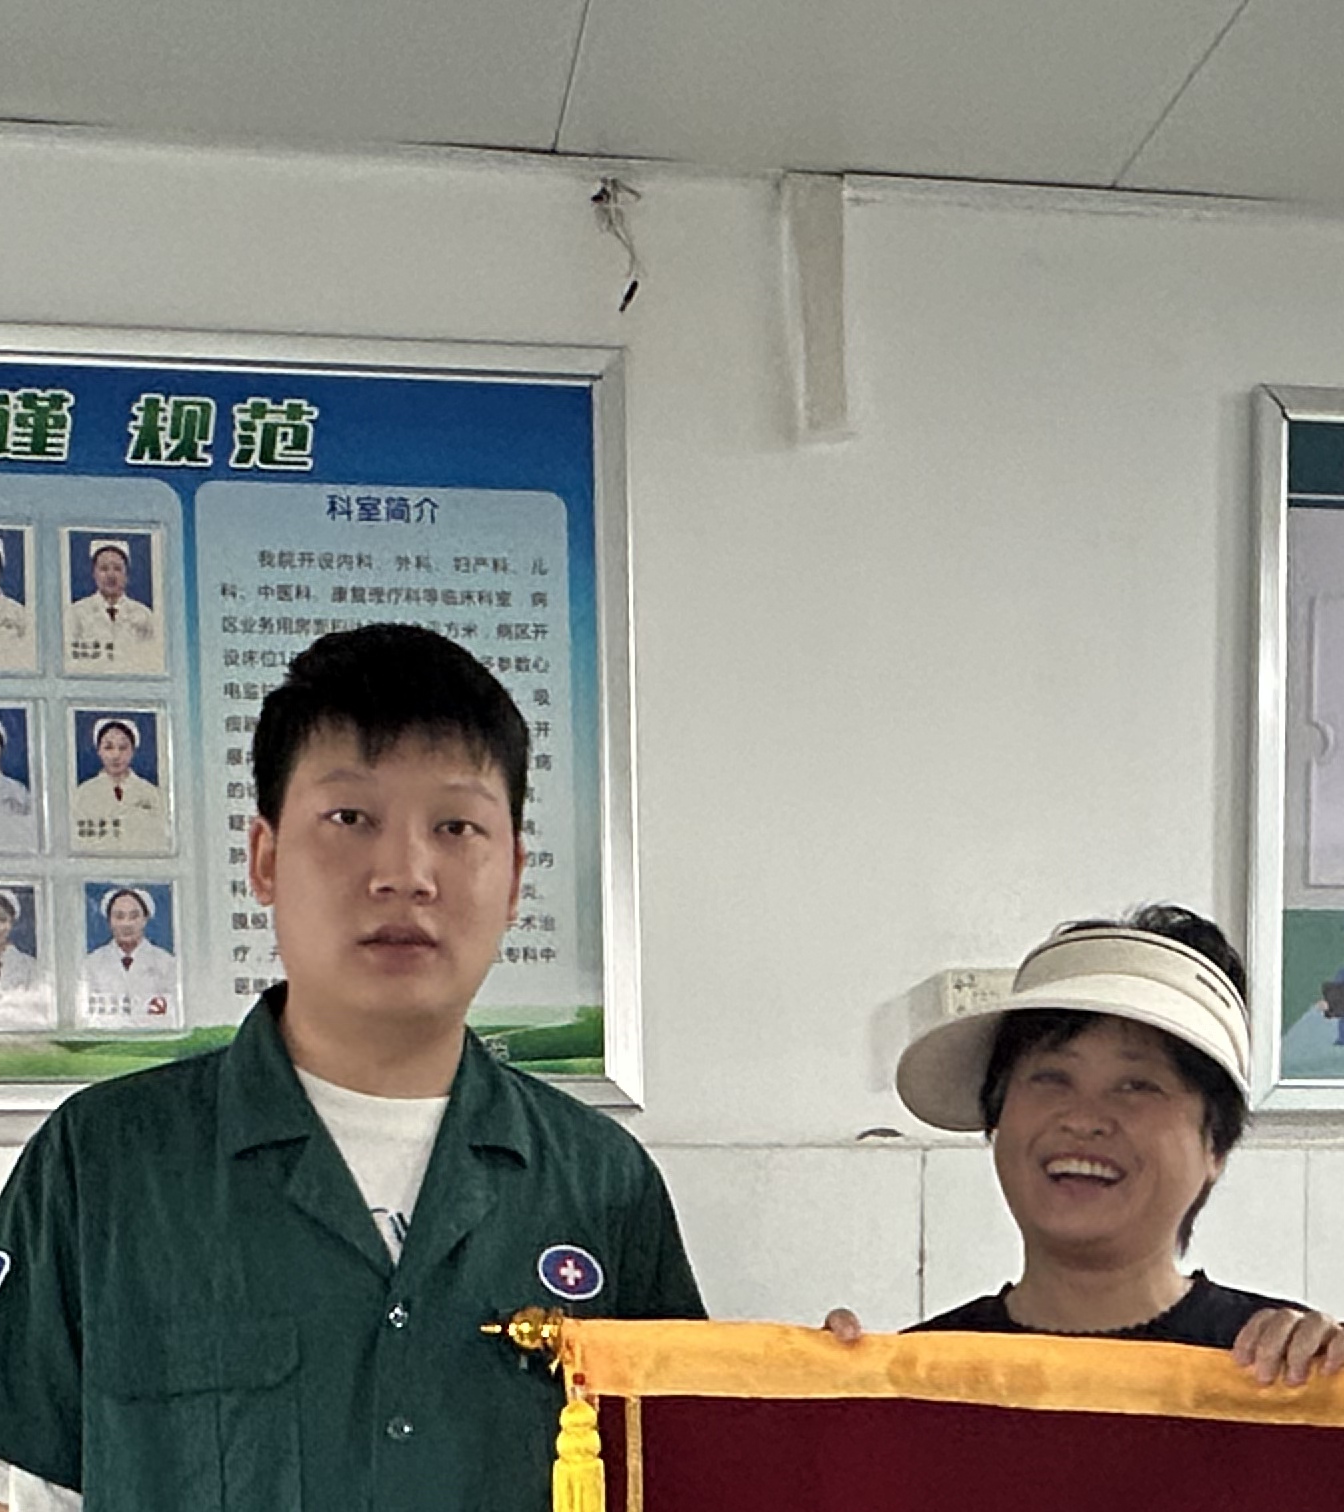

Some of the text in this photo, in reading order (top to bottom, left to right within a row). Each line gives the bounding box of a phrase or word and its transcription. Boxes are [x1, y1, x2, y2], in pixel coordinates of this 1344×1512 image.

[126, 393, 320, 470] 规范
[326, 494, 439, 523] 科室简介
